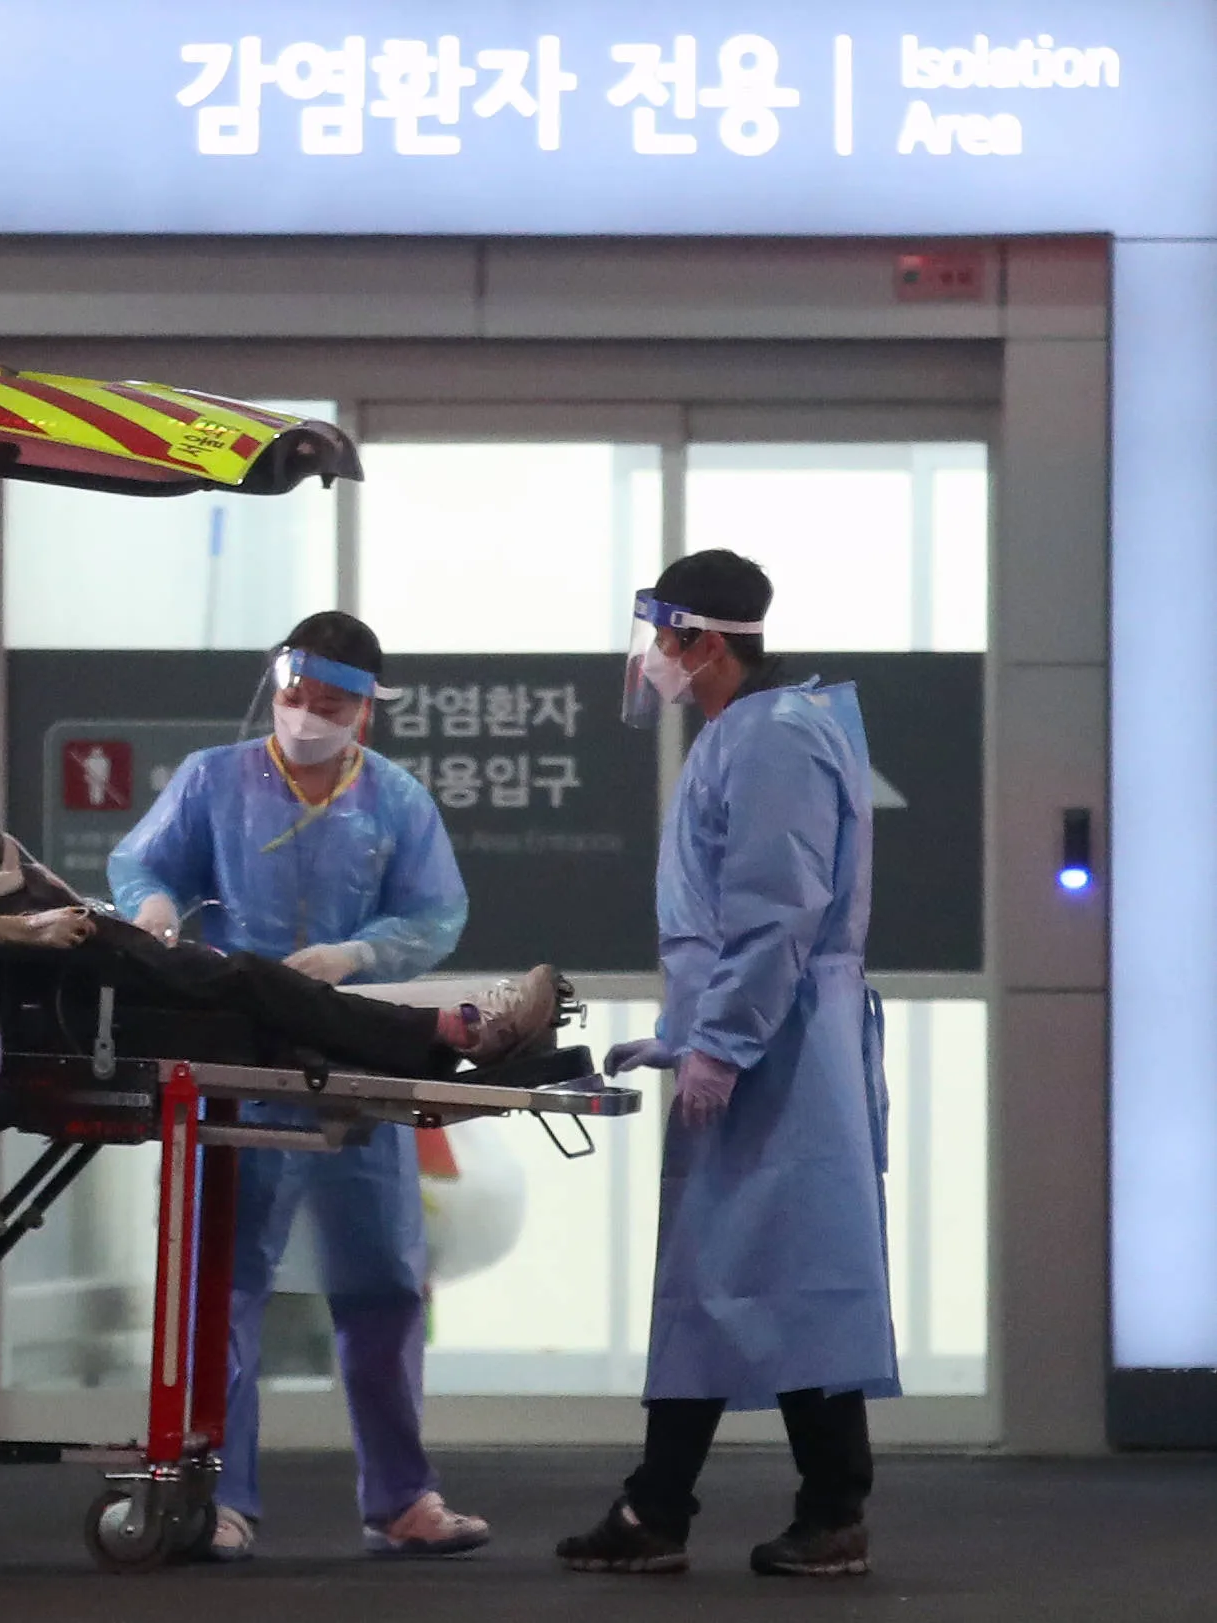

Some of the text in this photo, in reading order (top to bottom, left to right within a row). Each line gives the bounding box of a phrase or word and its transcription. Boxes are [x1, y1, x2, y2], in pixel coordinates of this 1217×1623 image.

[900, 33, 1121, 89] Isolation
[176, 33, 801, 157] 감염환자 전용
[897, 99, 1024, 156] Area
[385, 682, 583, 738] 감염환자
